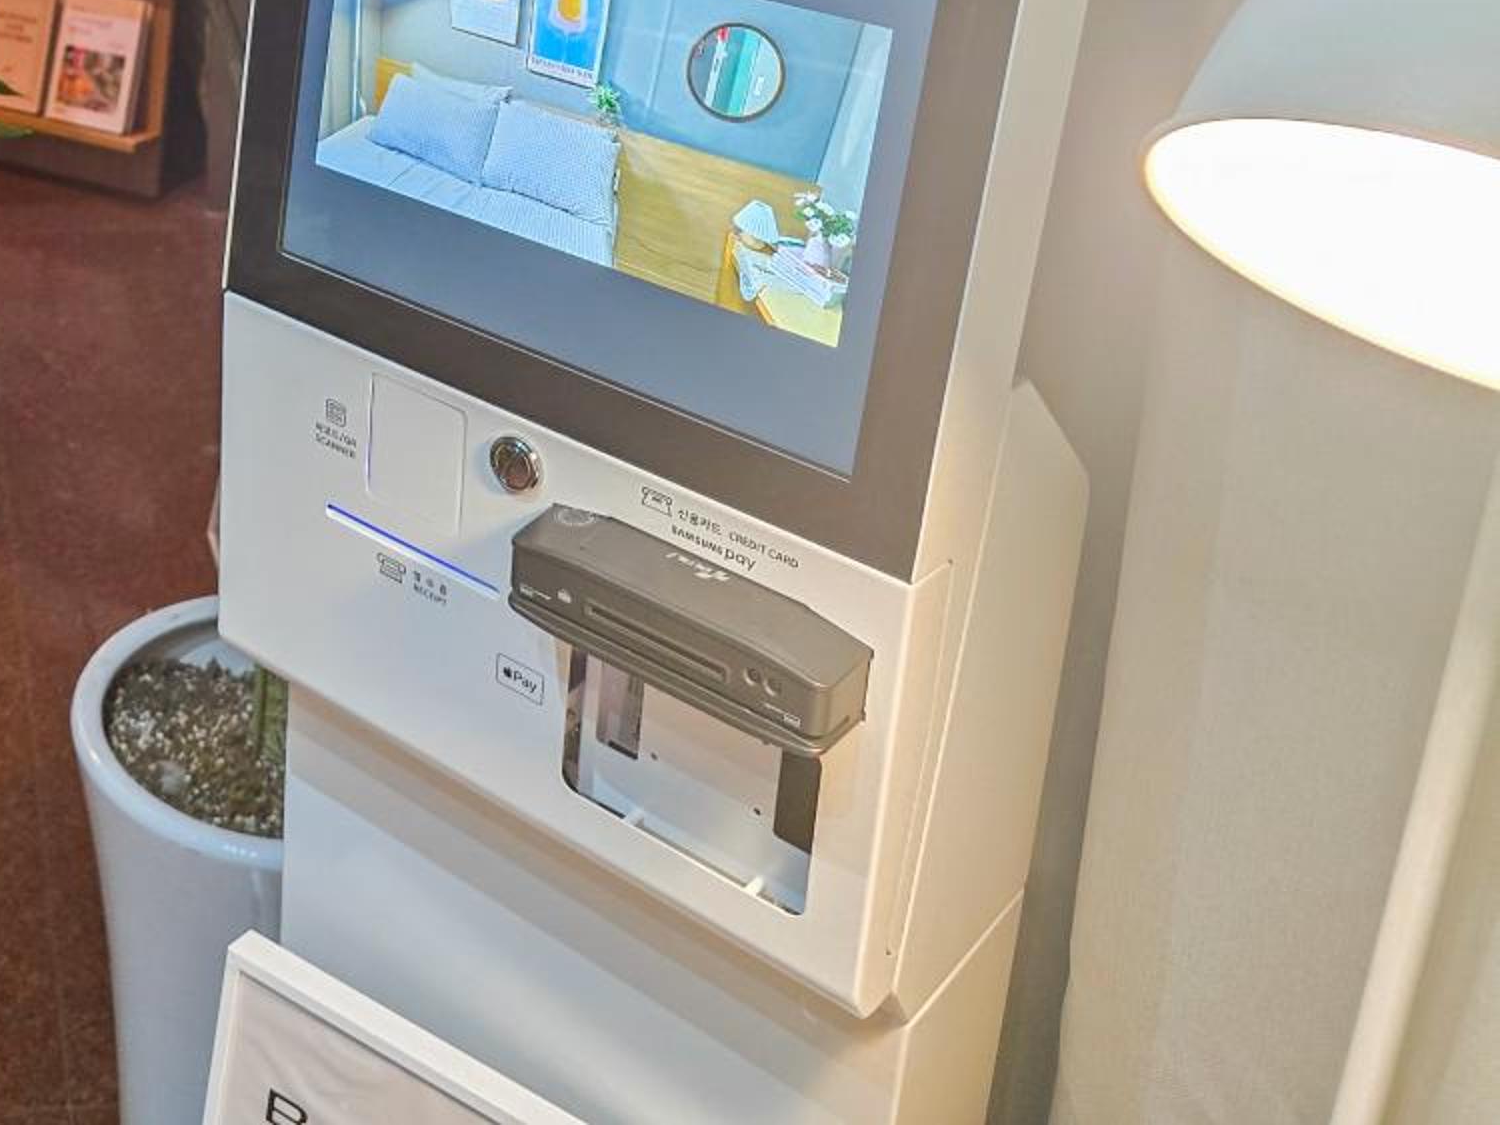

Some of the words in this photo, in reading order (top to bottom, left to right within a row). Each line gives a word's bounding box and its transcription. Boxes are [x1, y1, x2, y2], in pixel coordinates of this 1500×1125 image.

[671, 524, 723, 555] SAMSUNG
[723, 547, 757, 571] pay
[728, 530, 766, 556] CREDIT
[767, 548, 800, 568] CARD
[513, 670, 537, 693] Pay
